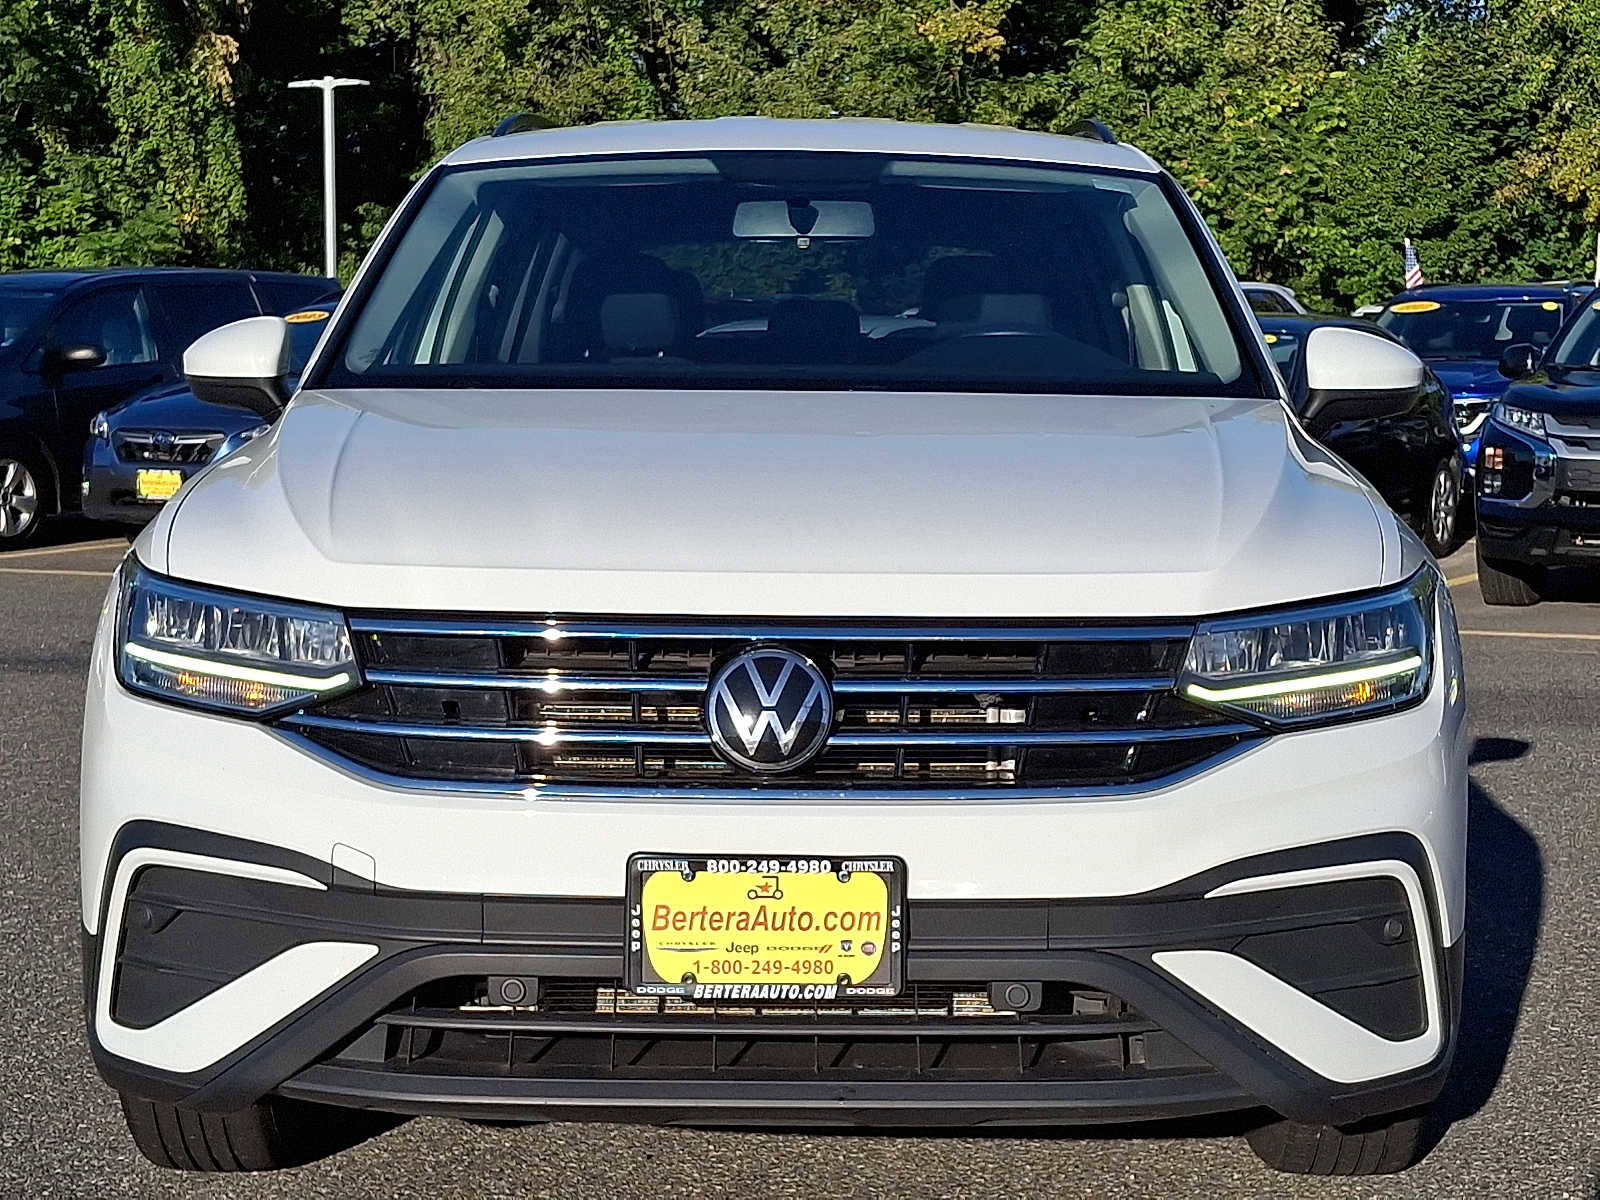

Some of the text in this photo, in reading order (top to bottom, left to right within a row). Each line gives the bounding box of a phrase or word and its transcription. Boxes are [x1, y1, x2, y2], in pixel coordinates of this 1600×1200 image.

[637, 860, 690, 872] CHRYSLER
[706, 859, 832, 873] 800-249-4980
[841, 861, 894, 872] CHRYSLER
[651, 904, 881, 931] BerteraAuto.com
[725, 941, 760, 955] Jeep
[692, 959, 834, 975] 1-800-249-4980
[636, 986, 686, 994] DODGE
[693, 984, 838, 1000] BERTERAAUTO.COM
[845, 987, 896, 995] DODGE
